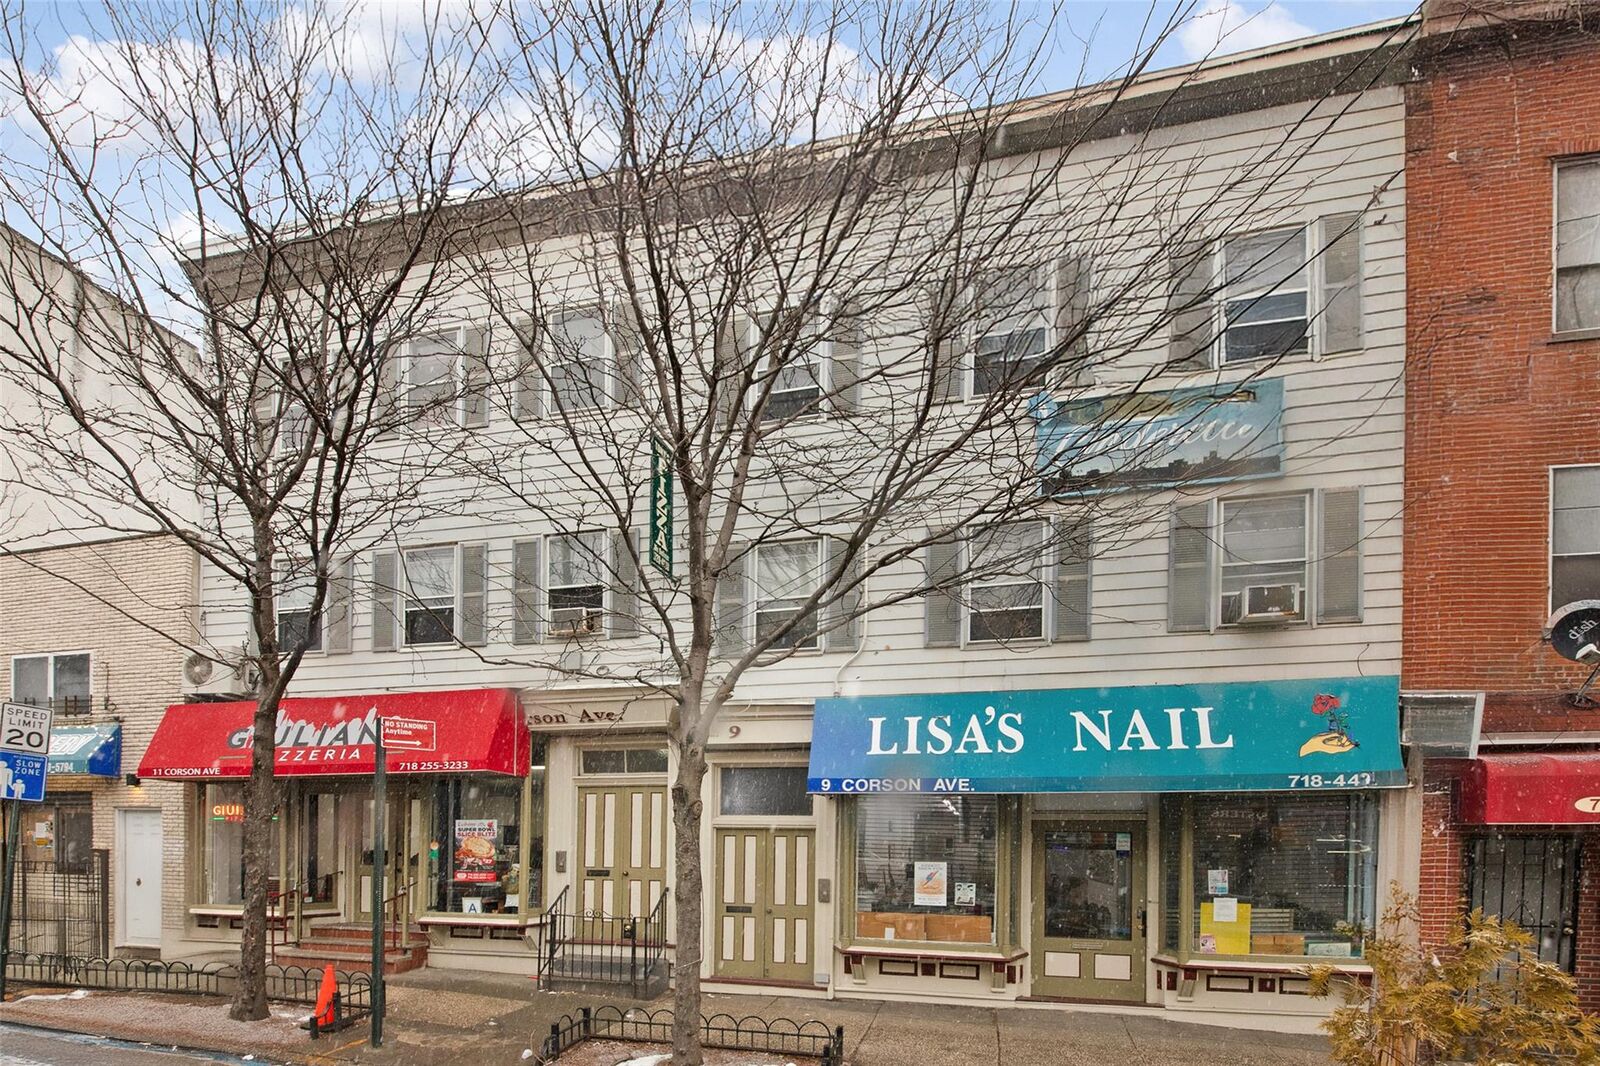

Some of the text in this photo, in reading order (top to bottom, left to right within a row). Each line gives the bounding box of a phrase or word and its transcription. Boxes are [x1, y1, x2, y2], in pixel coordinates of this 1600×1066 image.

[1568, 619, 1600, 640] dish
[7, 707, 48, 721] SPEED
[9, 719, 44, 730] LIMIT
[396, 721, 428, 730] STANDING
[384, 727, 413, 737] Anytime
[729, 725, 742, 739] 9
[866, 706, 1234, 756] LISA'S NAIL
[5, 728, 44, 748] 20
[277, 749, 361, 763] ZZERIA
[16, 759, 42, 769] SLOW
[400, 761, 469, 770] 718 255-3233
[14, 766, 41, 777] ZONE
[152, 767, 221, 776] 11 CORSON AVE
[821, 778, 975, 792] 9 CORSON AVE.
[1590, 798, 1600, 811] 7
[468, 903, 477, 913] A
